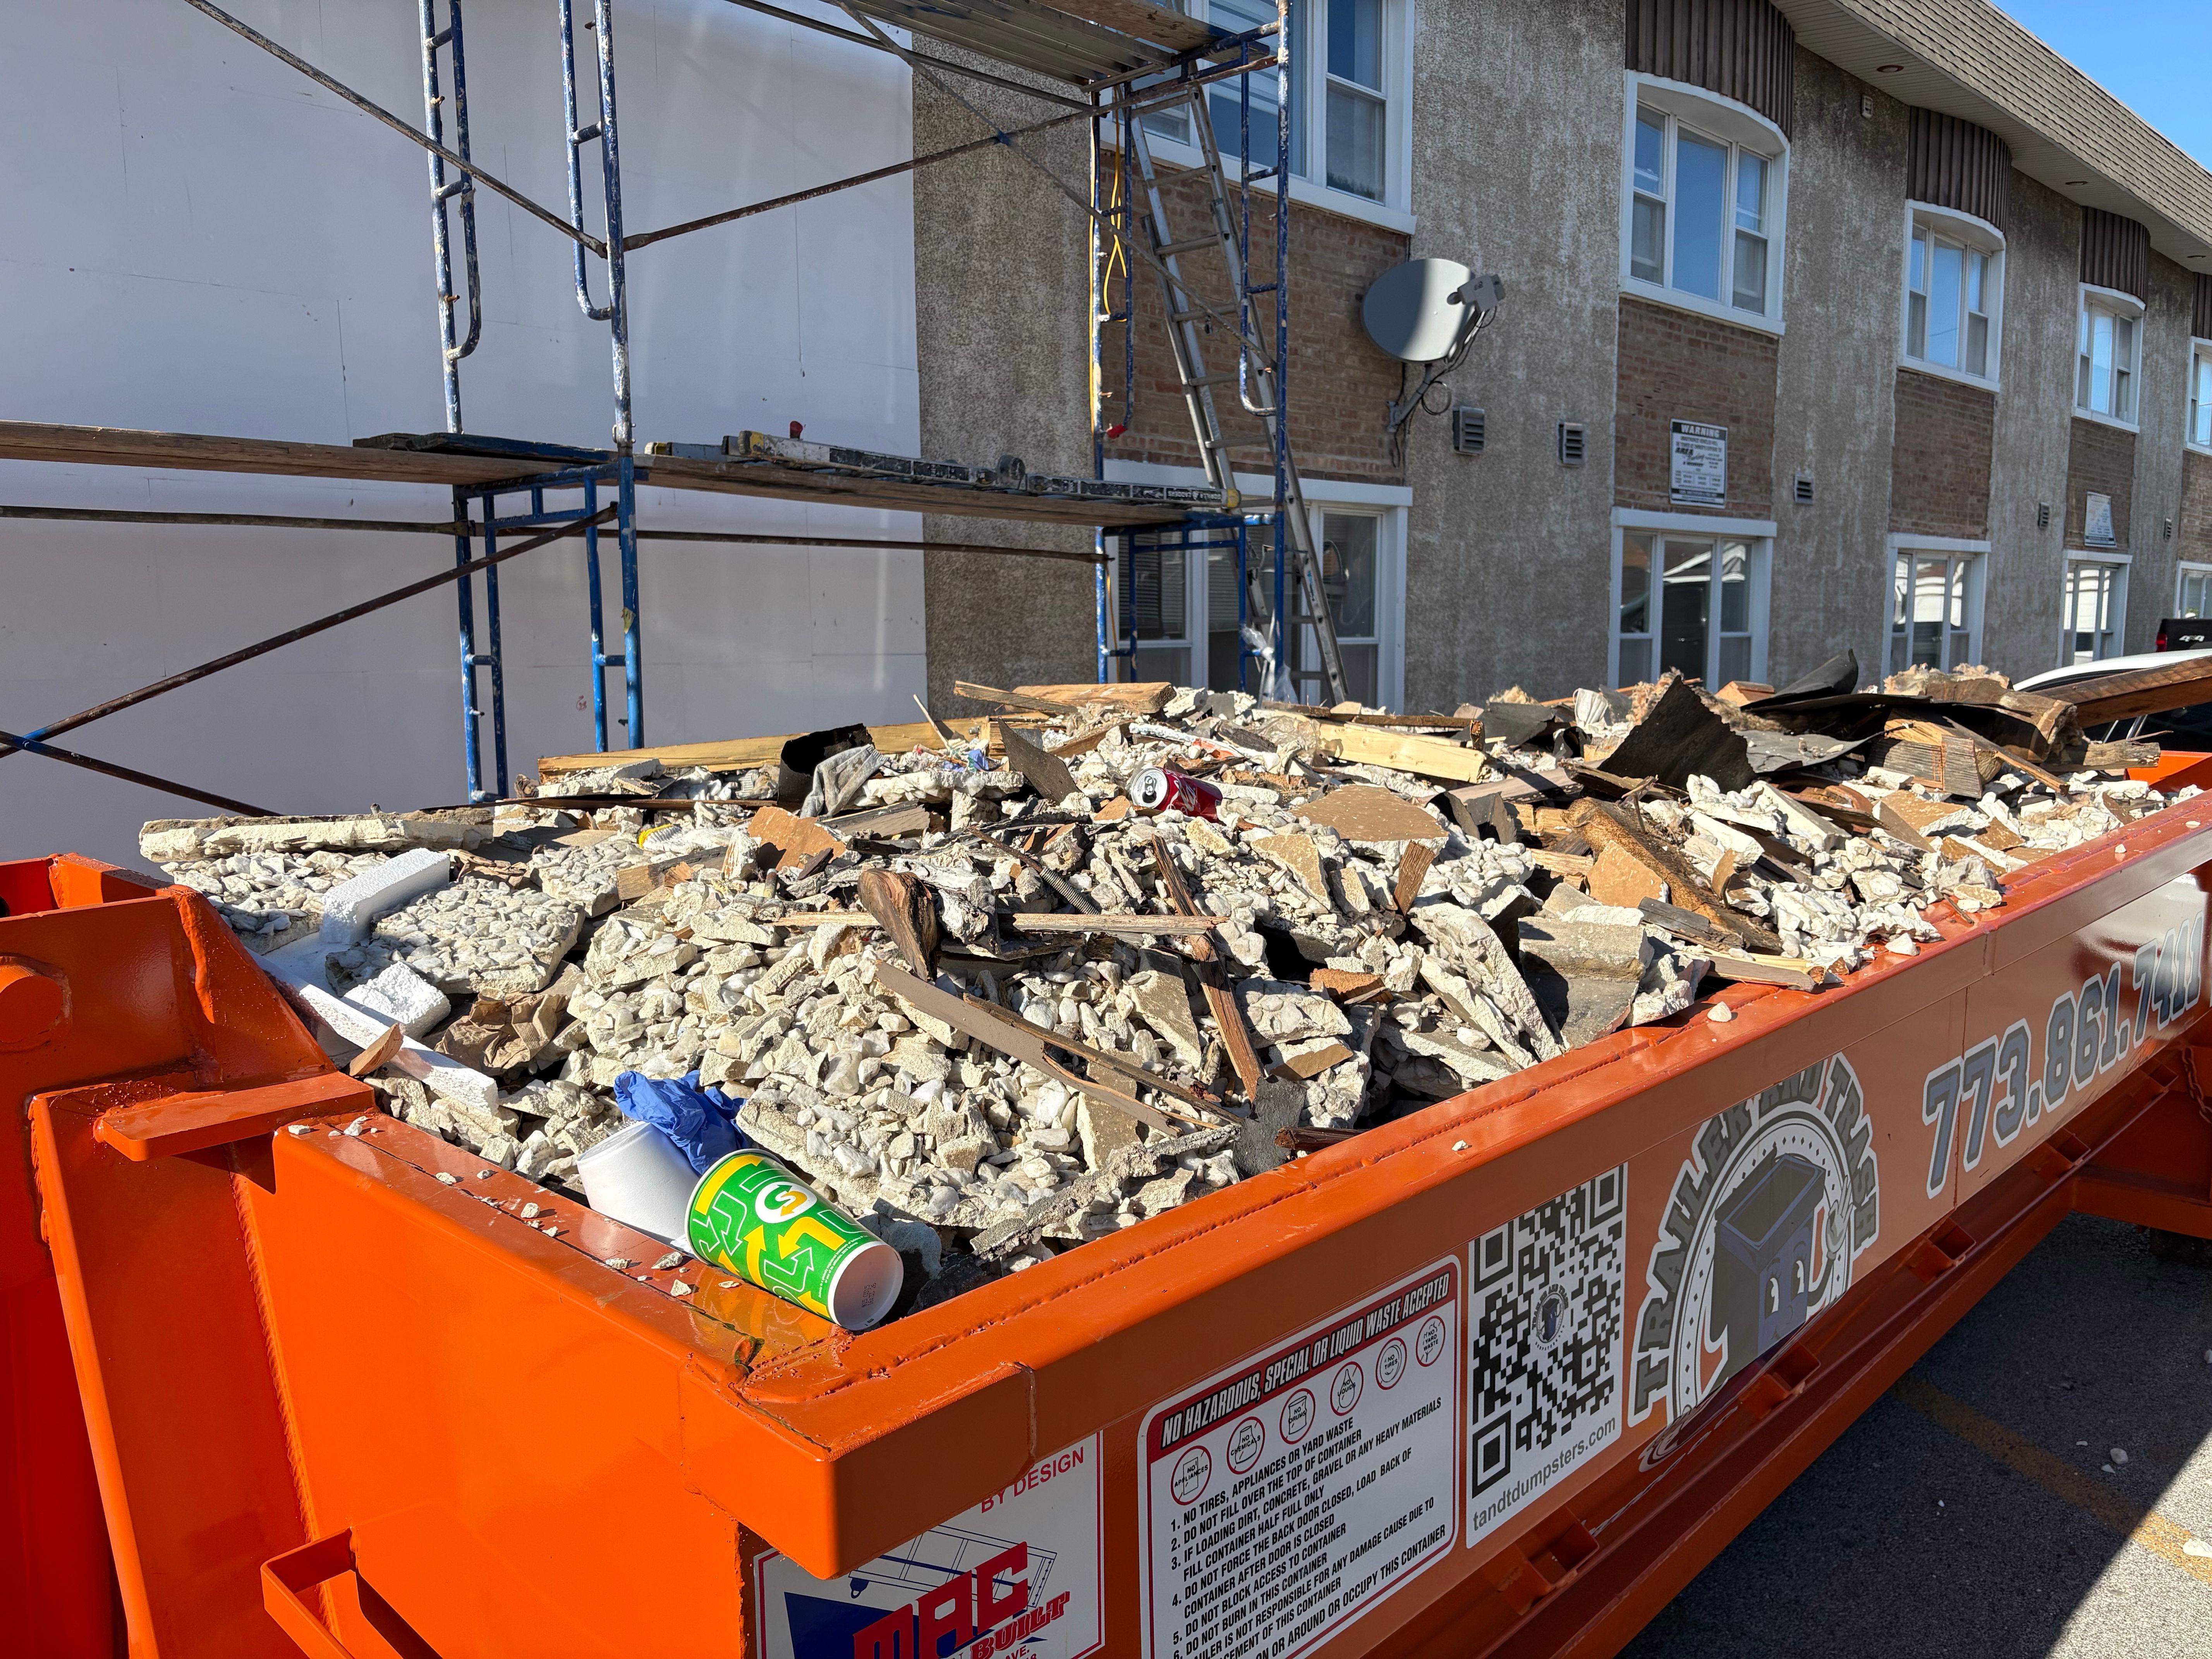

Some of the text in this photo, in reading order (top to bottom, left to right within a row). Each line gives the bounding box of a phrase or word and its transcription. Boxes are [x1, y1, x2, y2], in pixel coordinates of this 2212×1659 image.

[1681, 424, 1719, 438] WARNING
[1923, 911, 2203, 1199] 773.861.7411
[1633, 1099, 1753, 1416] TRAILER
[1823, 1056, 1876, 1252] TRASH
[1161, 1271, 1450, 1448] NO HAZARDOUS, SPECIAL OR LIQUID WASTE ACCEPTED
[1384, 1358, 1398, 1370] TIRES
[1388, 1353, 1395, 1362] NO
[1423, 1338, 1438, 1352] WASTE
[1425, 1333, 1437, 1345] YARD
[1231, 1434, 1261, 1456] CHEMICALS
[1242, 1434, 1249, 1443] NO
[1294, 1406, 1301, 1415] NO
[1013, 1446, 1084, 1497] DESIGN
[1170, 1416, 1353, 1532] 1. NO TIRES, APPLIANCES OR YARD WASTE
[1171, 1396, 1441, 1570] 3. IF LOADING DIRT, CONCRETE, GRAVEL OR ANY HEAVY MATERIALS
[1171, 1428, 1361, 1552] 2. DO NOT FILL OVER THE TOP OF CONTAINER
[1175, 1464, 1208, 1488] APPLIANCES
[1187, 1464, 1195, 1474] NO
[1473, 1417, 1615, 1531] tandtdumpsters.com
[1171, 1446, 1412, 1607] 4. DO NOT FORCE THE BACK DOOR CLOSED, LOAD BACK OF
[1183, 1484, 1324, 1582] FILL CONTAINER HALF FULL ONLY
[1184, 1513, 1334, 1619] CONTAINER AFTER DOOR IS CLOSED
[852, 1541, 1028, 1659] MAC
[970, 1590, 1070, 1659] BUILT
[1173, 1522, 1346, 1645] 5. DO NOT BLOCK ACCESS TO CONTAINER
[1186, 1636, 1199, 1656] DO
[1201, 1622, 1219, 1645] NOT
[1222, 1604, 1246, 1632] BURN
[1249, 1597, 1258, 1614] IN
[1260, 1583, 1279, 1606] THIS
[1281, 1552, 1327, 1591] CONTAINER
[1194, 1496, 1434, 1659] ULER IS NOT RESPONSIBLE FOR ANY DAMAGE CAUSE DUE TO
[1220, 1576, 1341, 1659] EMENT OF THIS CONTAINER
[1272, 1637, 1285, 1657] OR
[1287, 1608, 1325, 1647] AROUND
[1328, 1597, 1340, 1617] OR
[1343, 1570, 1378, 1607] OCCUPY
[1380, 1556, 1399, 1580] THIS
[1401, 1523, 1445, 1566] CONTAINER
